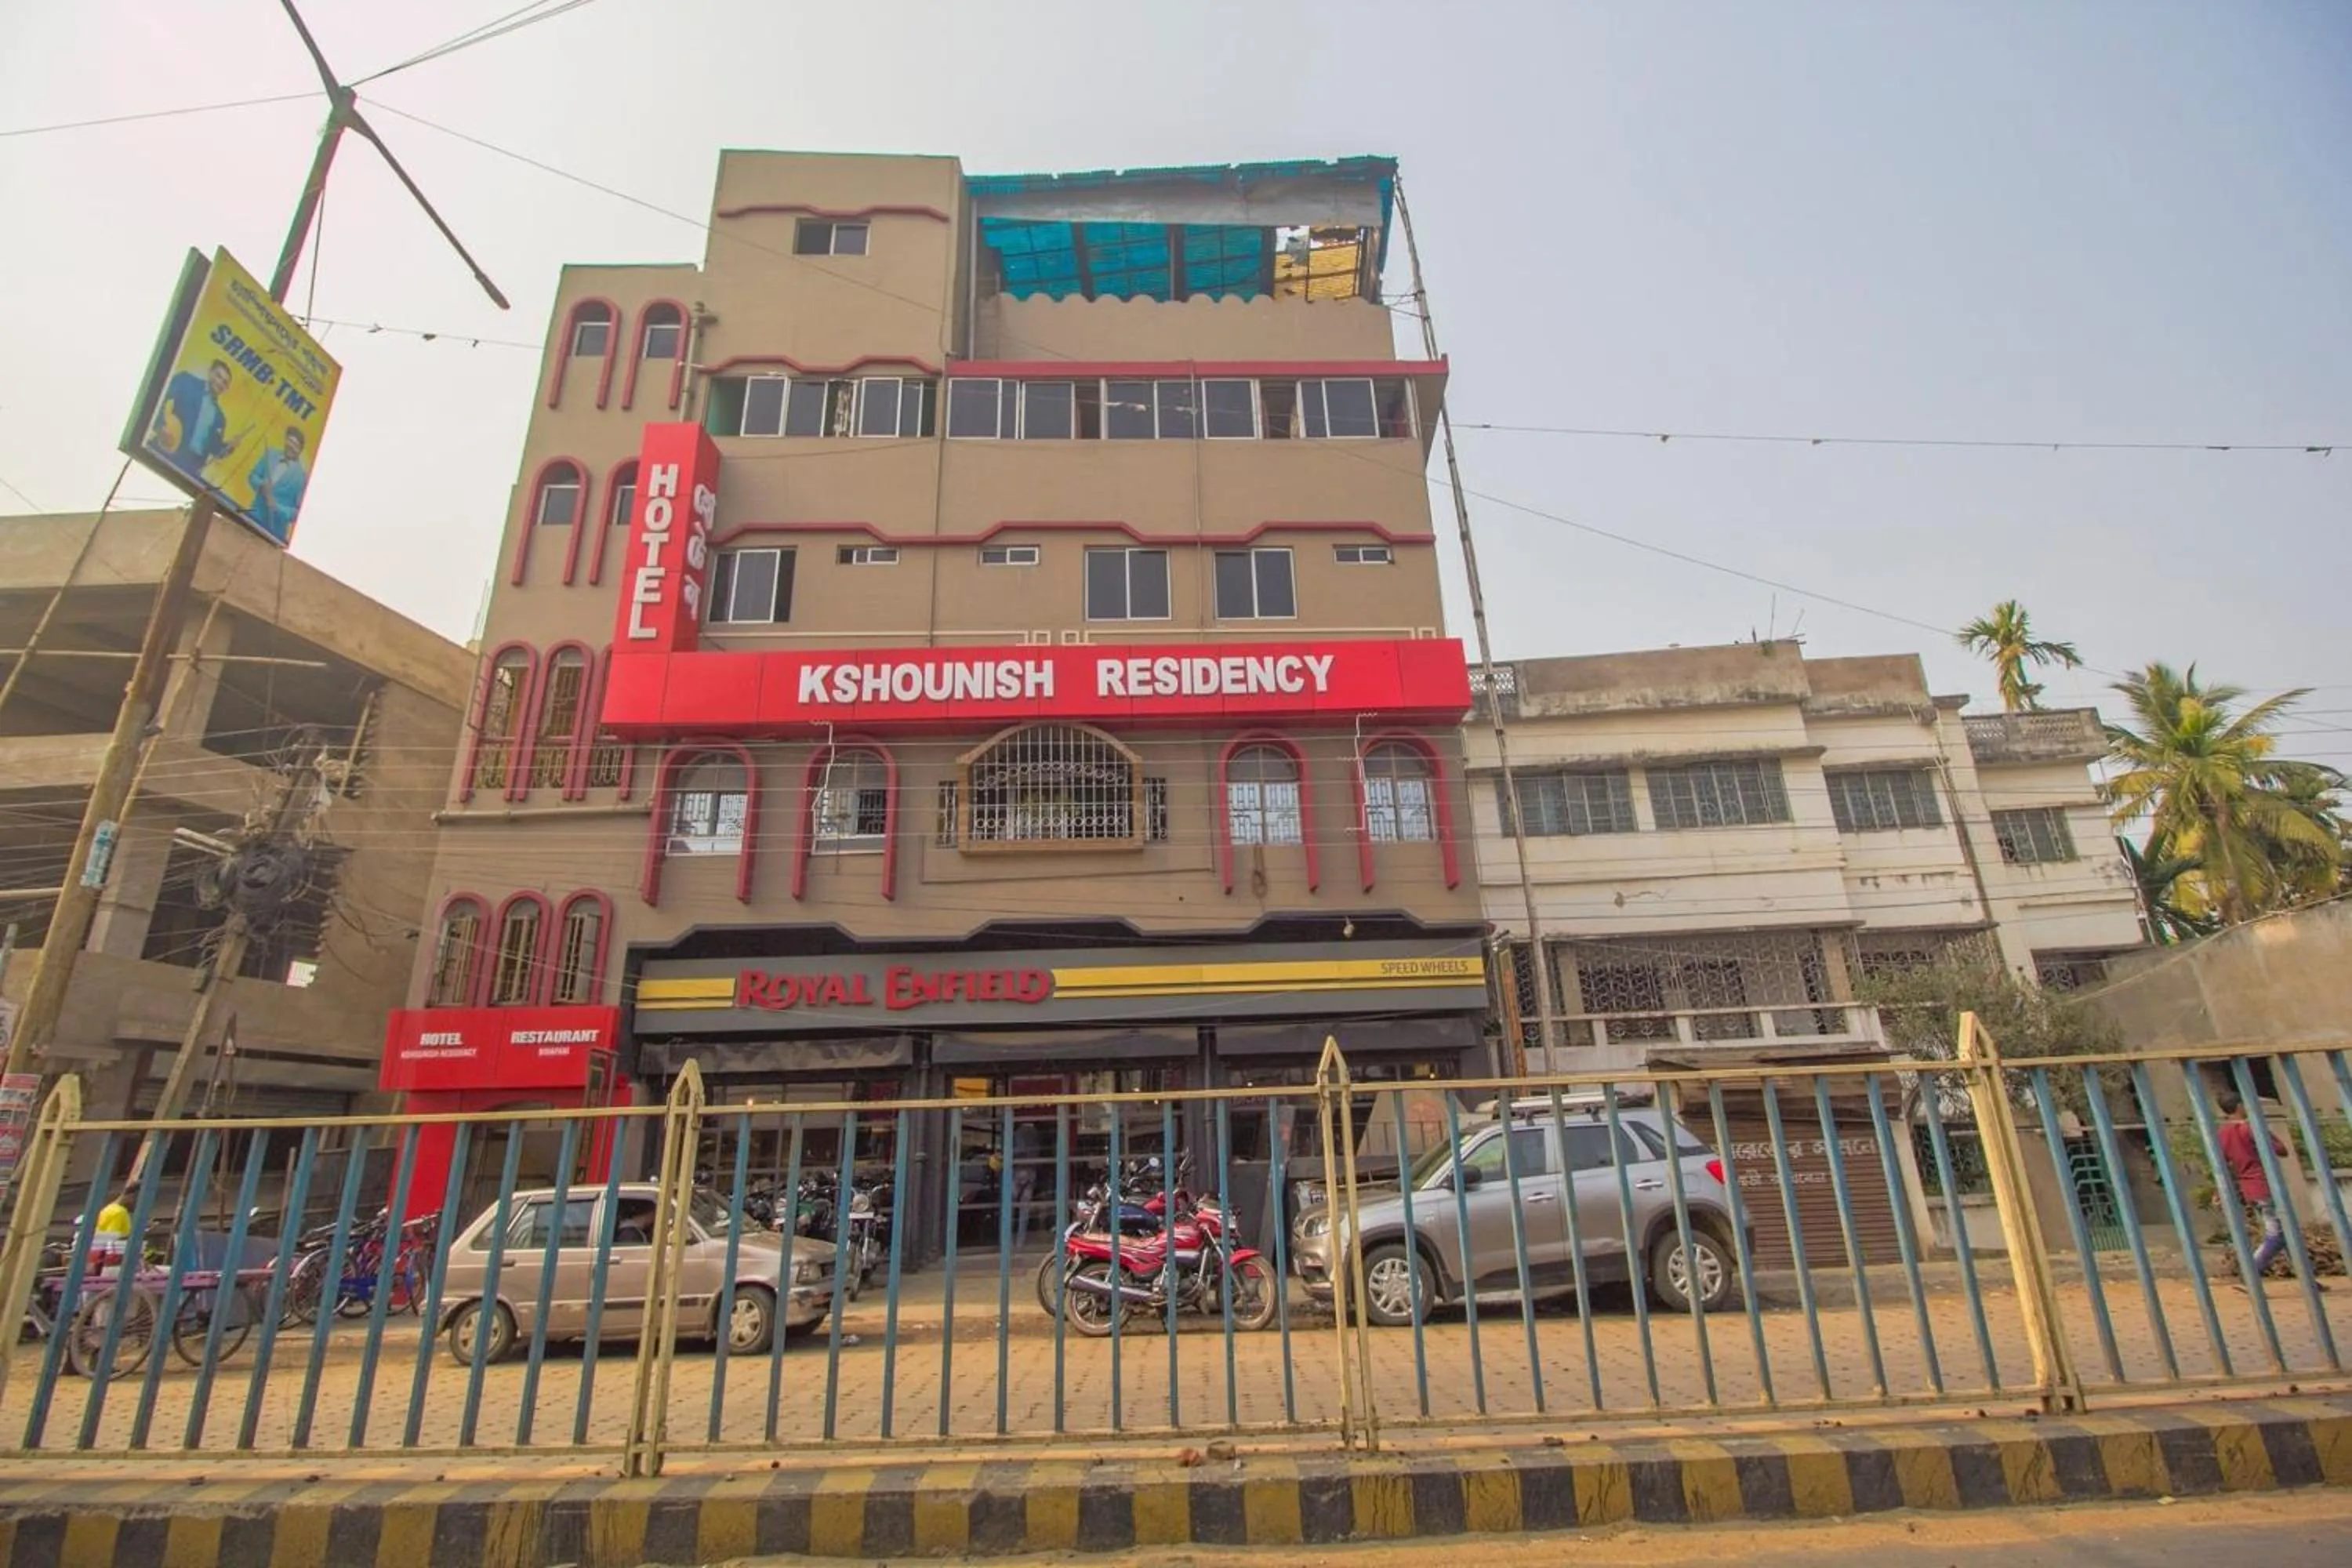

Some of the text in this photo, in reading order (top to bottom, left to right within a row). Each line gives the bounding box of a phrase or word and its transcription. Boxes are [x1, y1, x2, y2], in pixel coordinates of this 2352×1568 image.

[275, 376, 316, 421] TMT
[628, 463, 679, 639] HOTEL
[798, 655, 1334, 703] KSHOUNISH RESIDENCY
[737, 966, 1051, 1011] ROYAL ENFIELD
[1381, 960, 1469, 975] SPEED WHEELS
[419, 1033, 463, 1046] HOTEL
[511, 1029, 599, 1044] RESTAURANT
